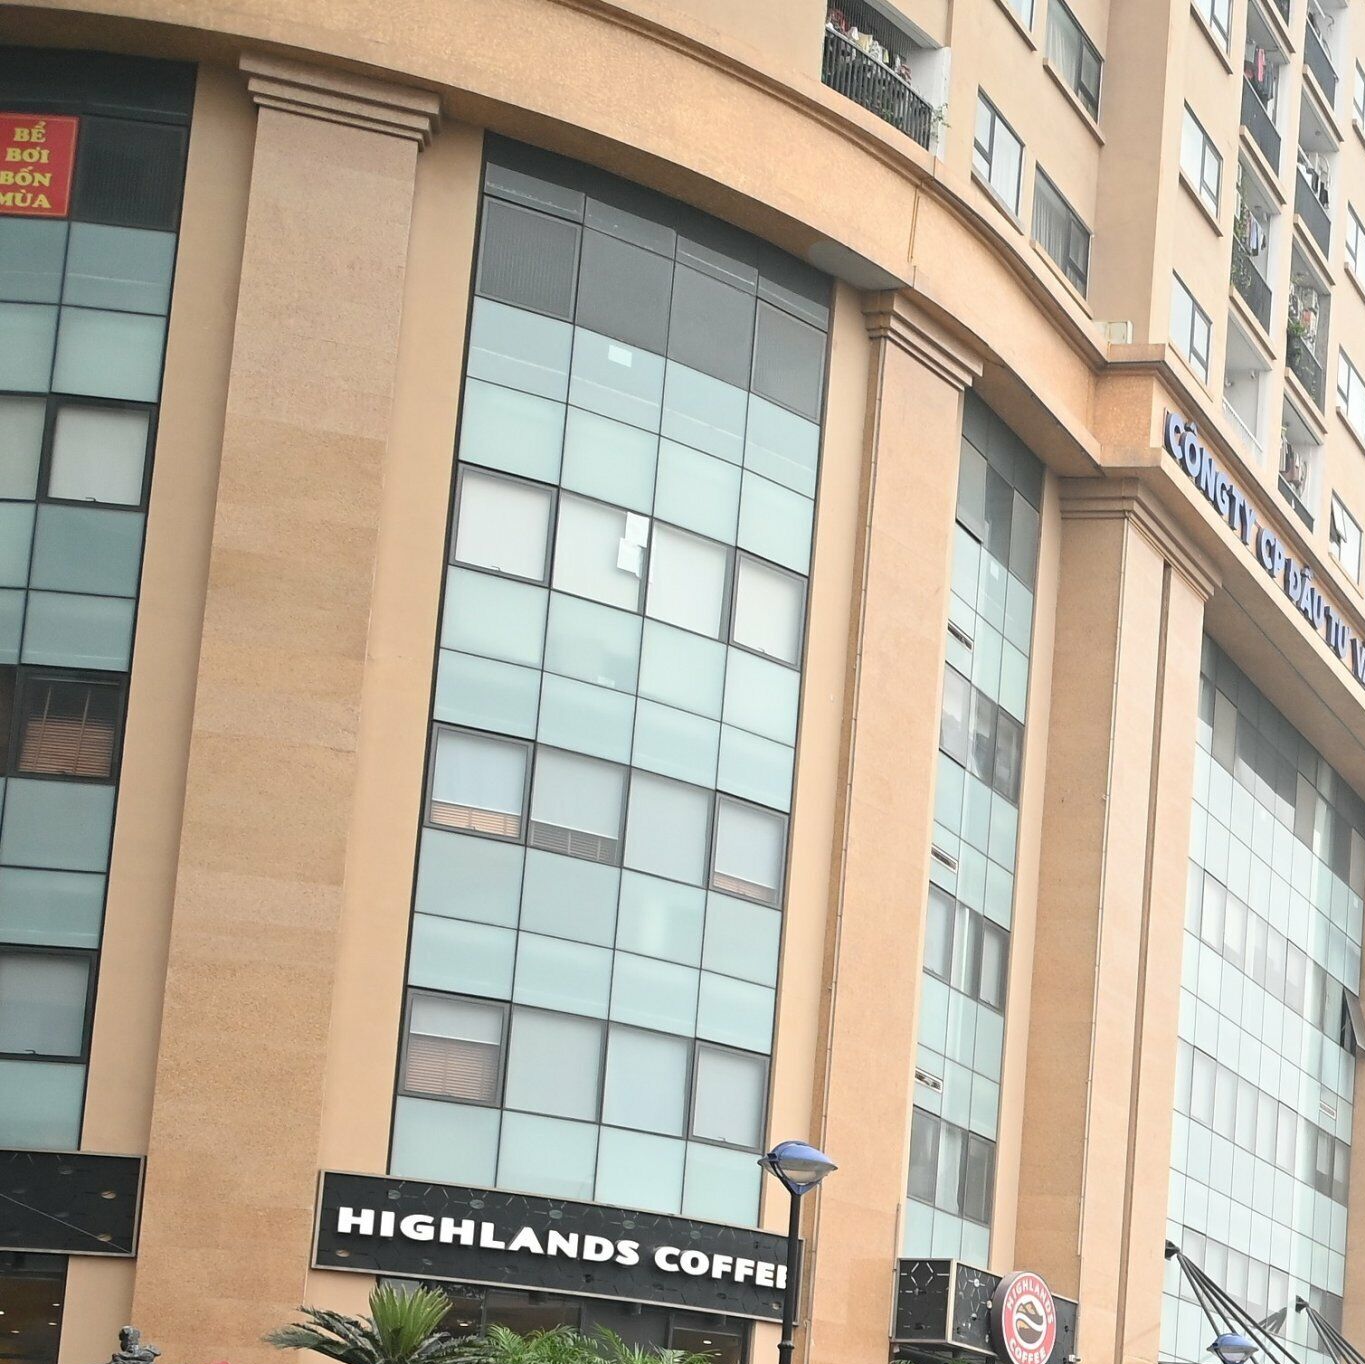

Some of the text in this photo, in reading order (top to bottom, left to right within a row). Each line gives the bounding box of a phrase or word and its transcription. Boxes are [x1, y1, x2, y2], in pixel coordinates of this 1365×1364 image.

[13, 120, 47, 143] BỂ
[5, 146, 50, 164] BƠI
[0, 165, 53, 187] BỐN
[337, 1206, 640, 1266] HIGHLANDS
[1006, 1278, 1054, 1325] HIGHLANDS
